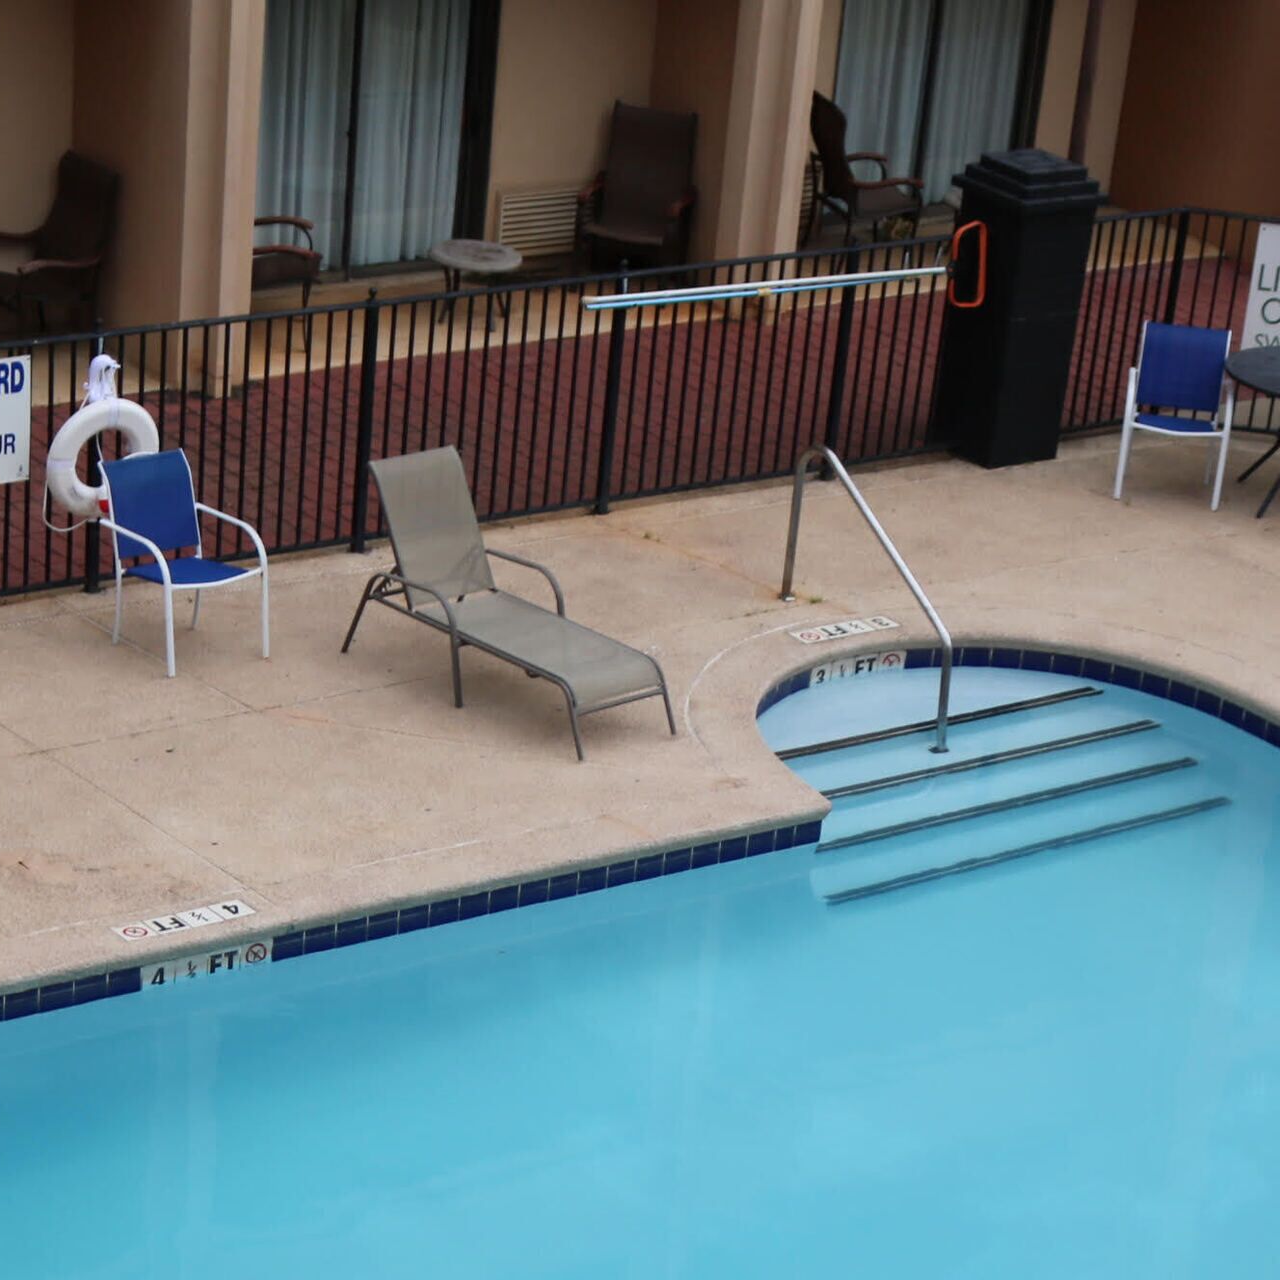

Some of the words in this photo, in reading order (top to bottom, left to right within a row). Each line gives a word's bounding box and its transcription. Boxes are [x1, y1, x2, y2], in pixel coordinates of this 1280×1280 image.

[821, 625, 848, 637] FT
[855, 657, 877, 674] FT
[222, 904, 240, 915] 4
[153, 917, 186, 932] FT
[151, 966, 166, 986] 4
[209, 950, 239, 974] FT
